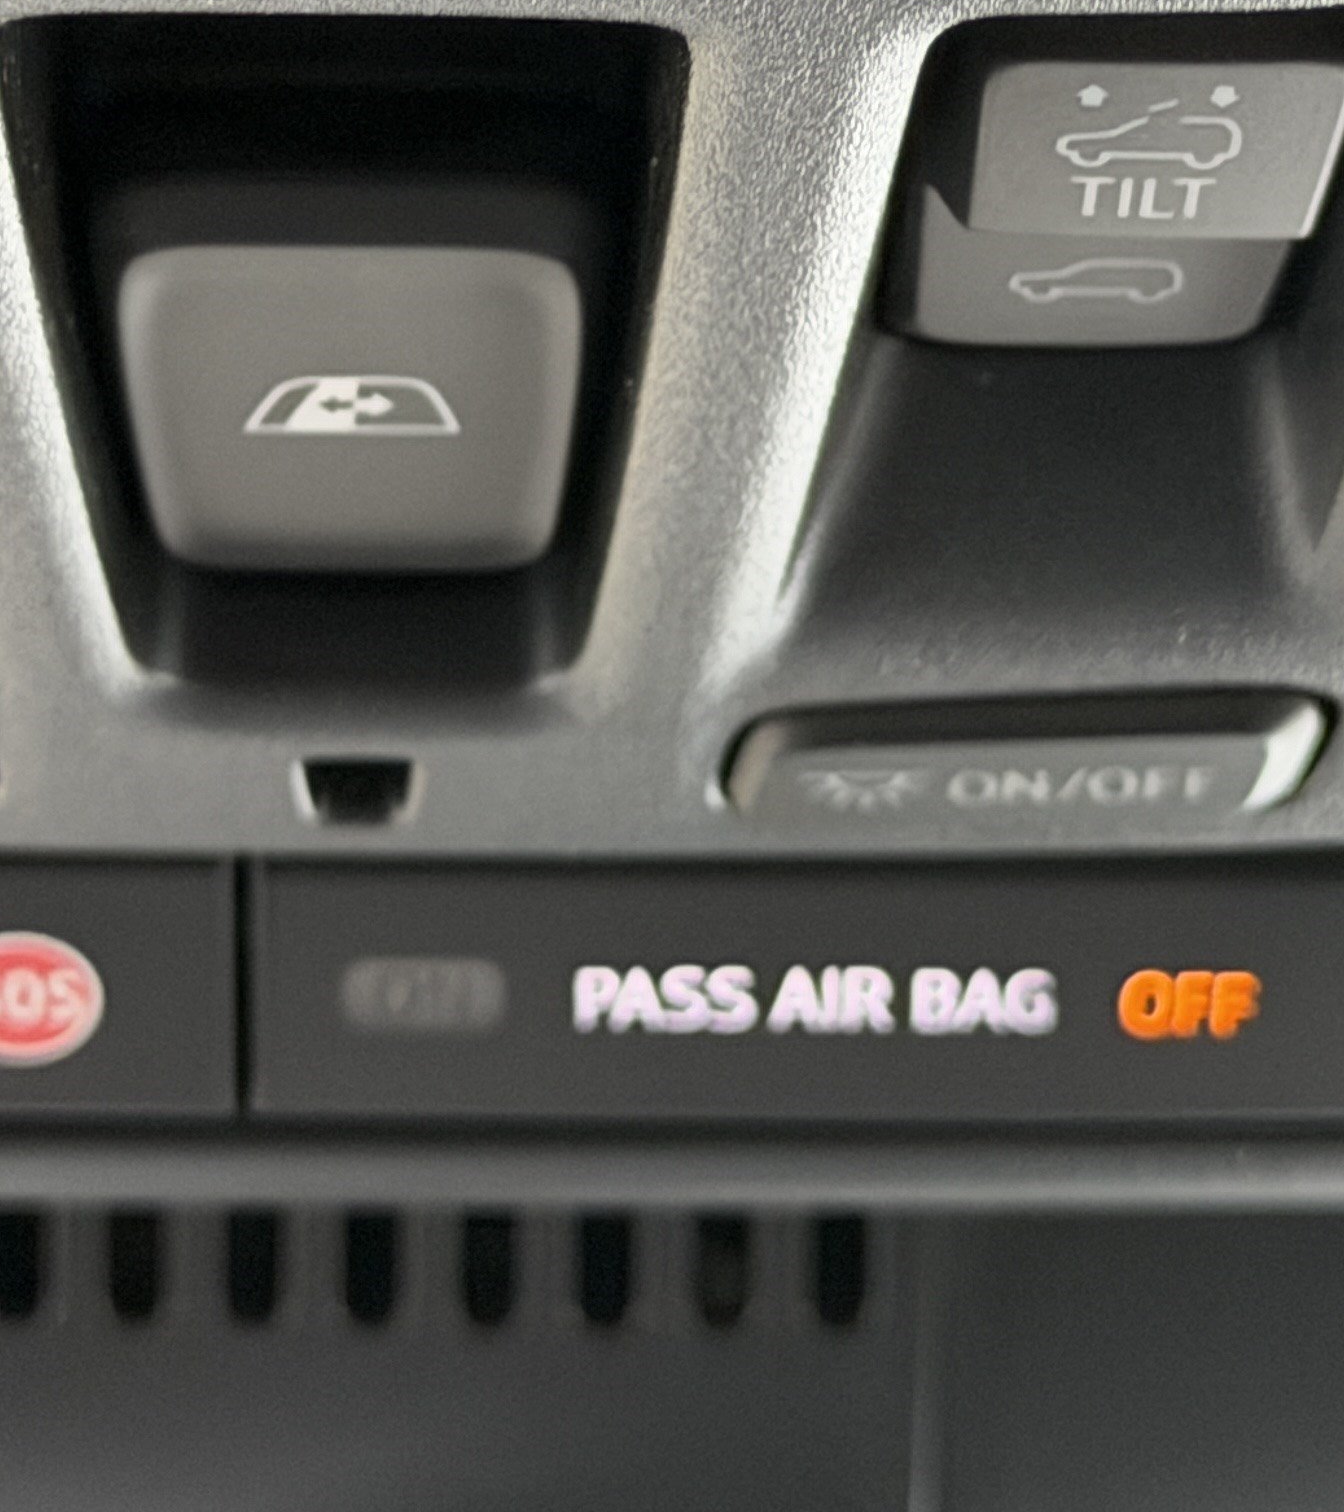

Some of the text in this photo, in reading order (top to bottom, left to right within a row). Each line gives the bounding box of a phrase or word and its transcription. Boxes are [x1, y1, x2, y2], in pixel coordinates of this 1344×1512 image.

[1070, 175, 1218, 220] TILT
[571, 964, 758, 1035] PASS
[766, 964, 897, 1035] AIR
[908, 966, 1058, 1036] BAG
[1117, 968, 1262, 1040] OFF
